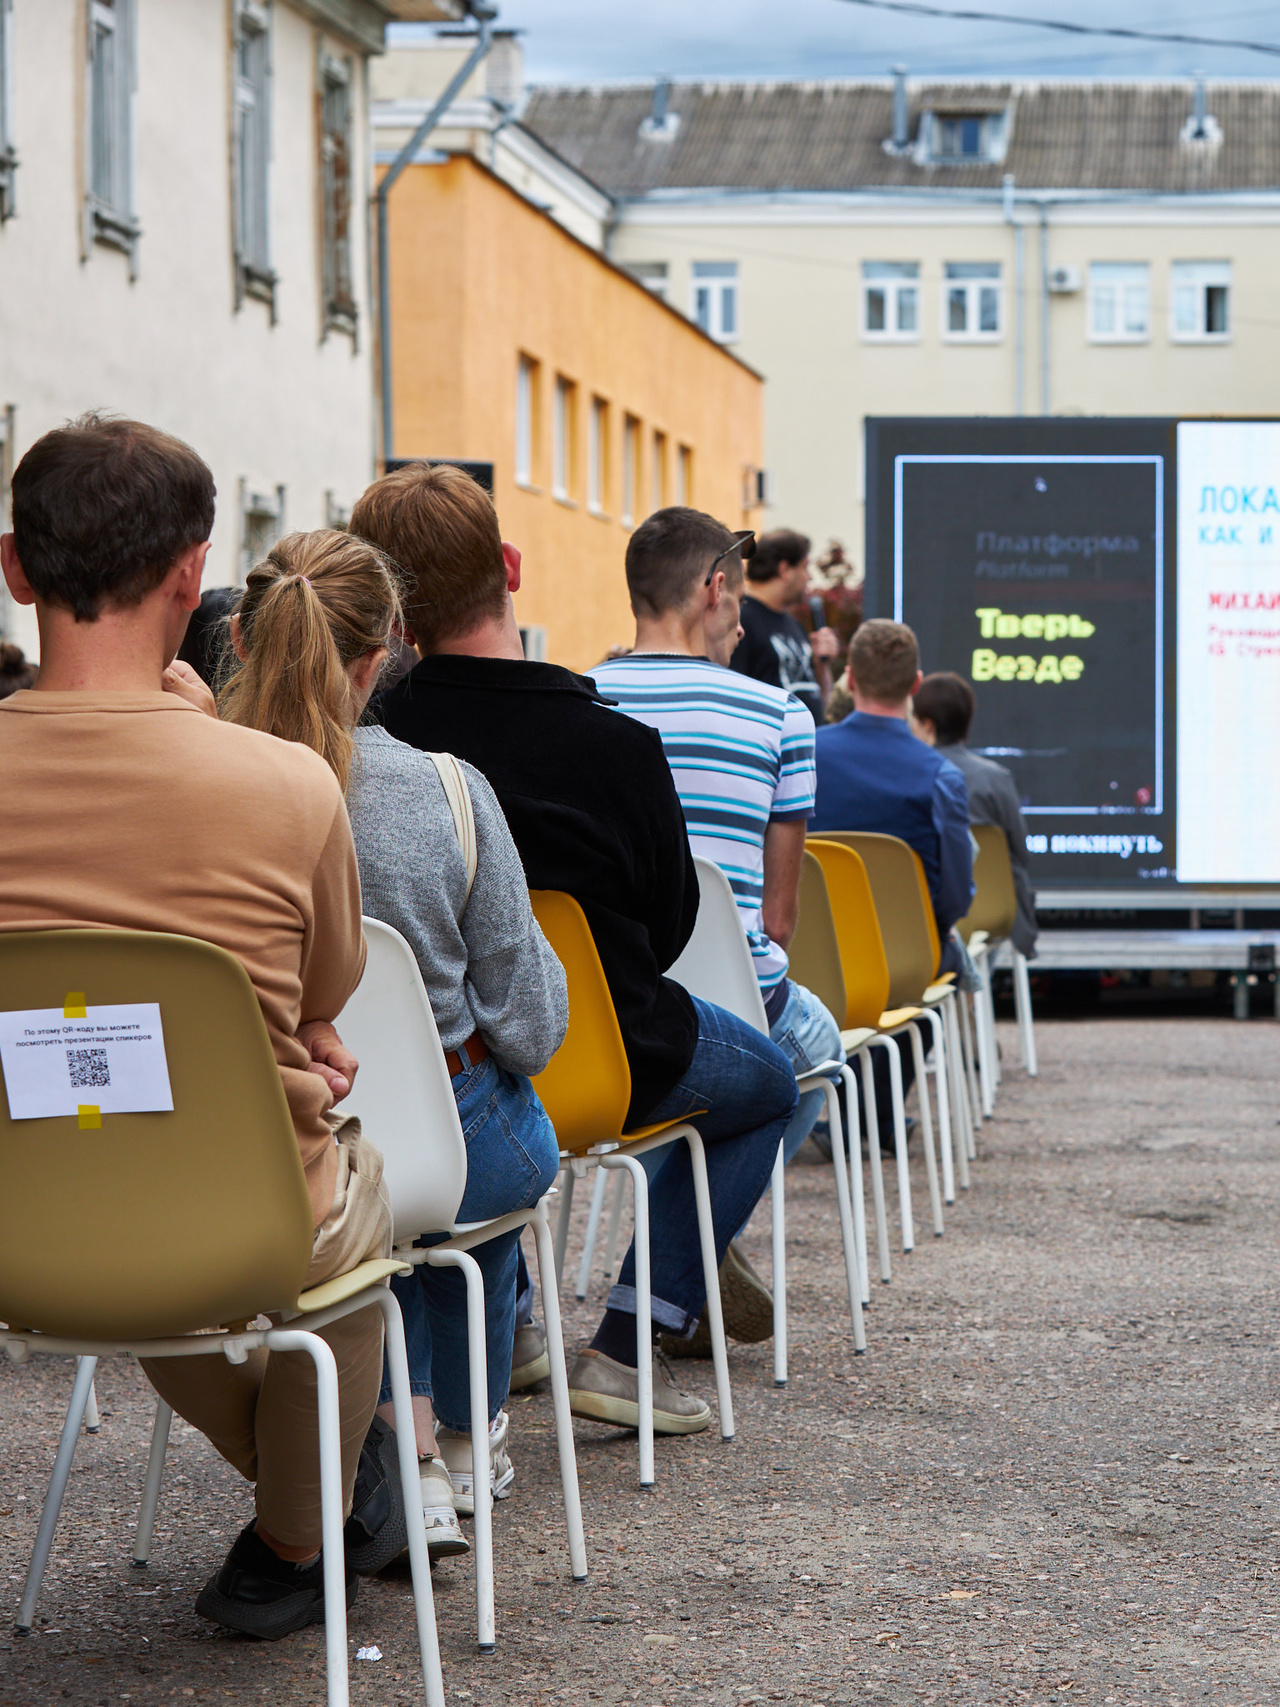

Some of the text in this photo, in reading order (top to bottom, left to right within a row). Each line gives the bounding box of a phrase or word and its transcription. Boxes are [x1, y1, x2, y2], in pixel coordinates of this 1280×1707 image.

[1199, 525, 1242, 545] КАК
[1259, 525, 1273, 545] И
[975, 608, 1096, 641] Тверь
[971, 648, 1085, 684] Везде
[62, 1026, 95, 1034] QR-коду
[16, 1034, 152, 1047] посмотреть презентации спикеров
